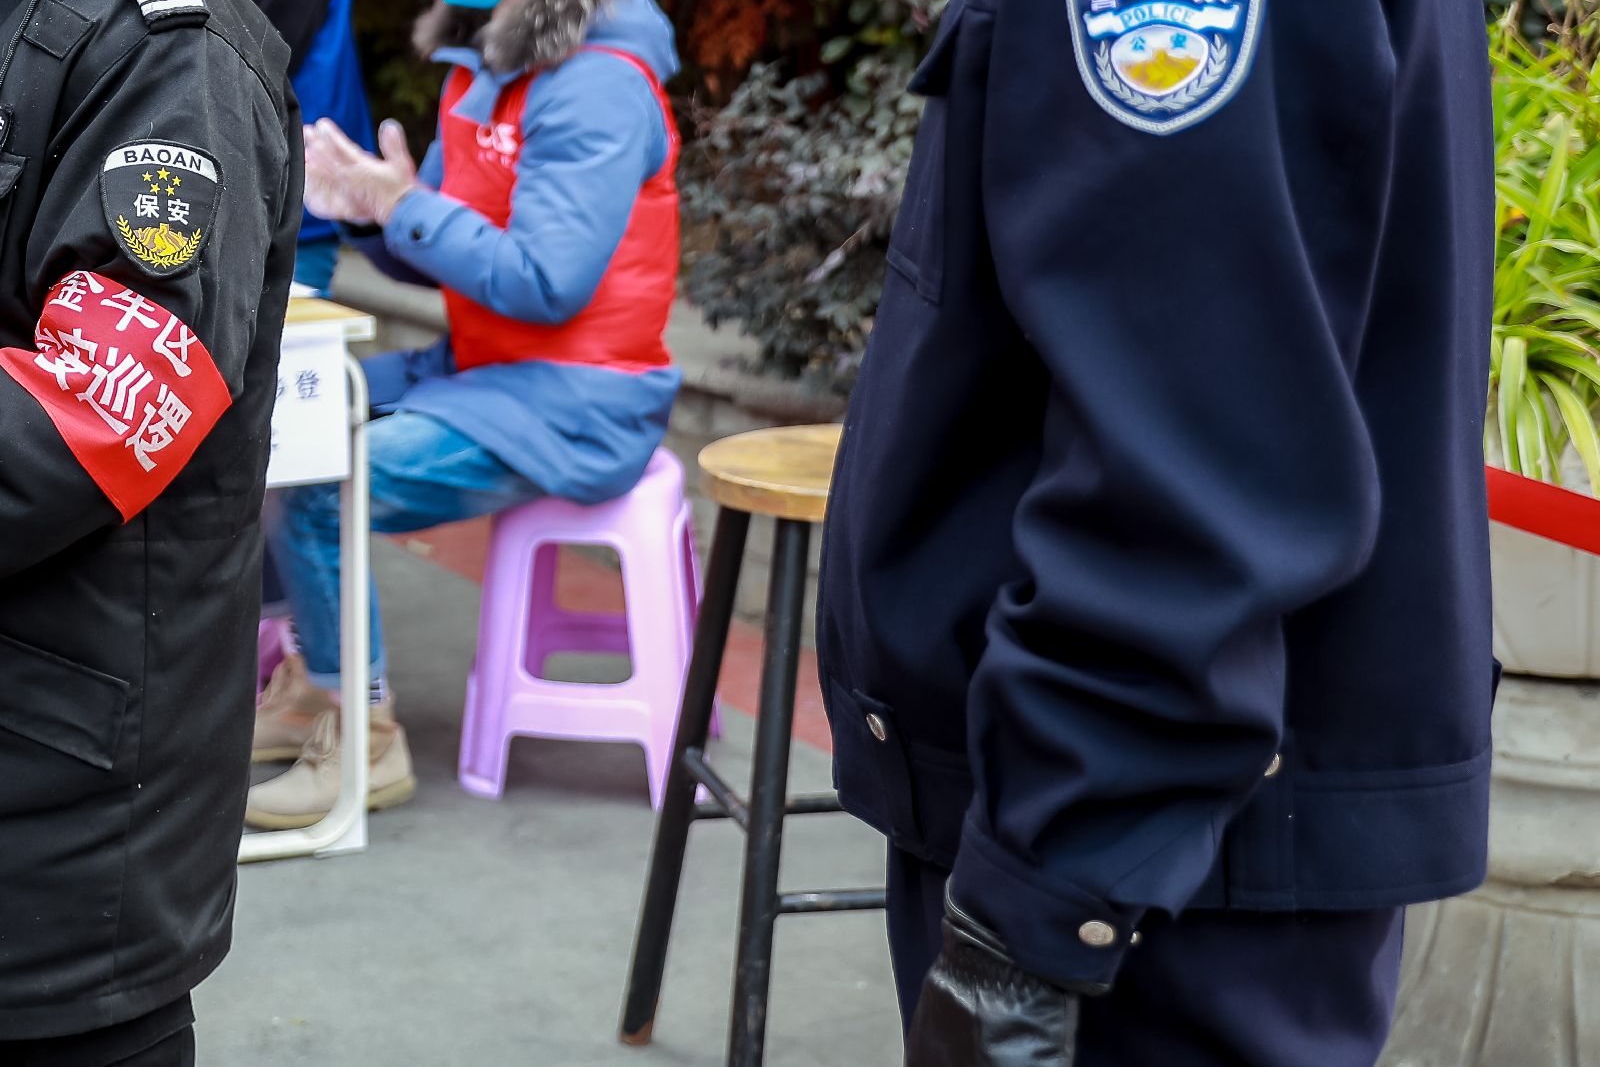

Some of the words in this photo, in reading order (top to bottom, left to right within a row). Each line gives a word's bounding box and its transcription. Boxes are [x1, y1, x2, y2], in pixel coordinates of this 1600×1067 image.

[1119, 3, 1195, 29] POLICE
[123, 147, 202, 171] BAOAN
[133, 193, 190, 225] 保安
[48, 270, 199, 378] 金牛区
